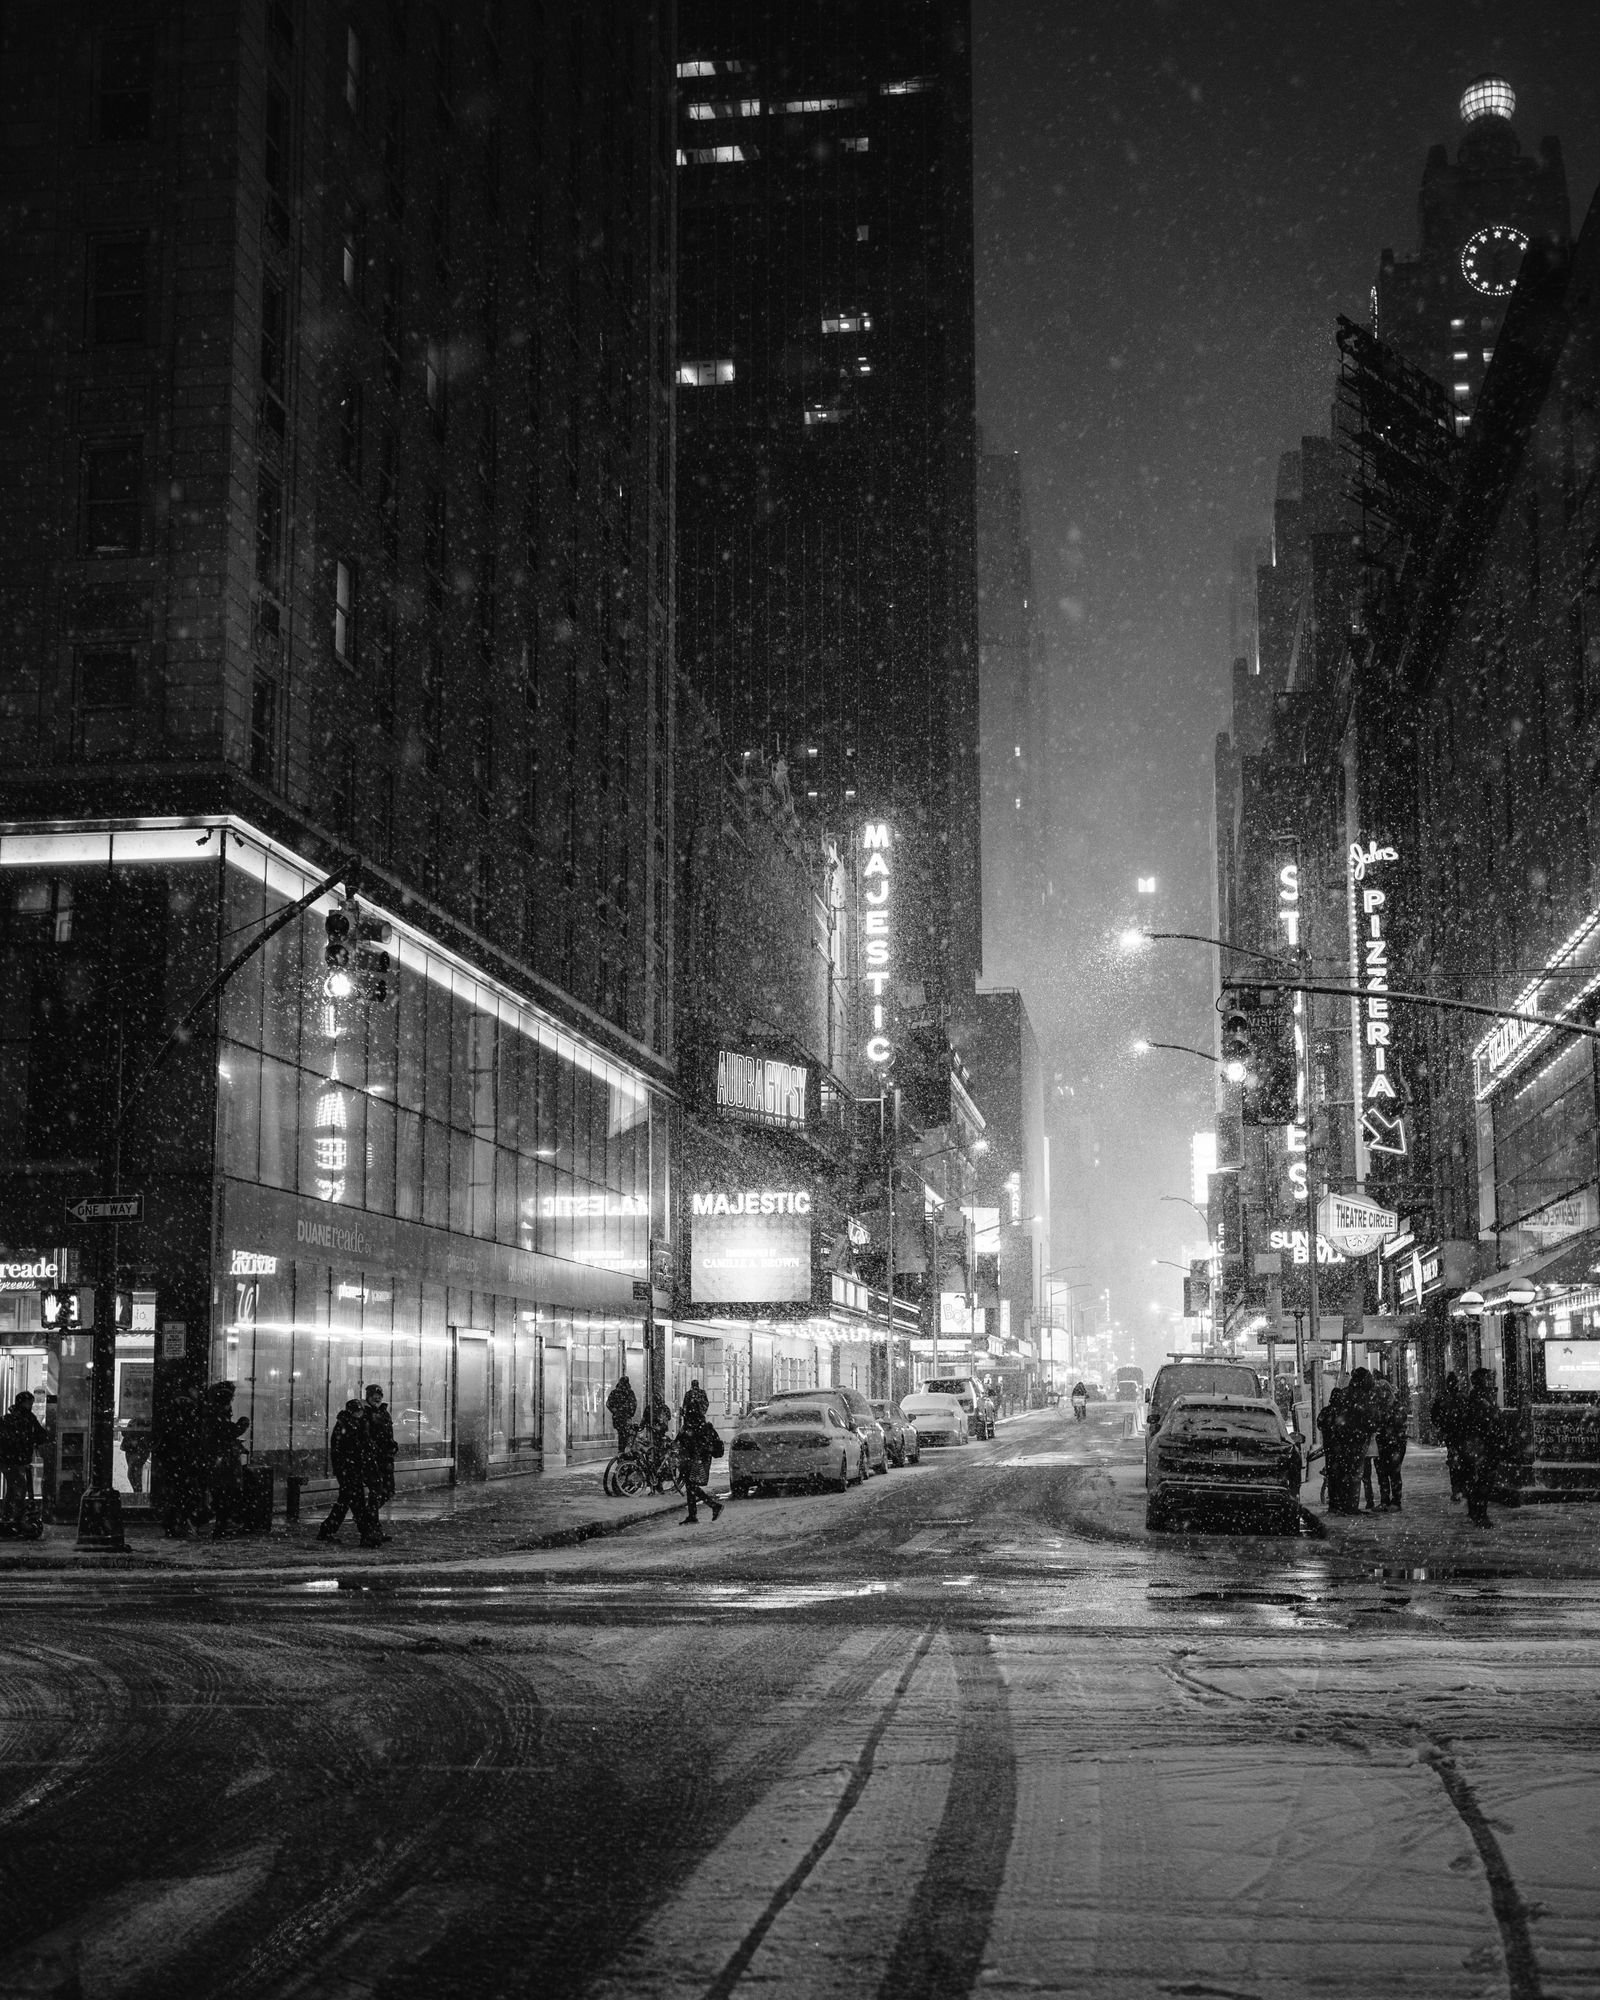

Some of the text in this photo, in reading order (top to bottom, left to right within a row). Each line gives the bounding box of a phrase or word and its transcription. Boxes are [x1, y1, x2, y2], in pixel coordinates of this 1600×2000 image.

[863, 824, 890, 1062] MAJESTIC
[1364, 890, 1396, 1098] PIZZERIA
[765, 1060, 807, 1119] GYPSY
[77, 1203, 133, 1216] ONE WAY
[692, 1191, 811, 1215] MAJESTIC
[1336, 1203, 1393, 1229] THEATRE CIRCLE
[0, 1257, 59, 1278] reade
[1556, 1434, 1598, 1444] Terminal
